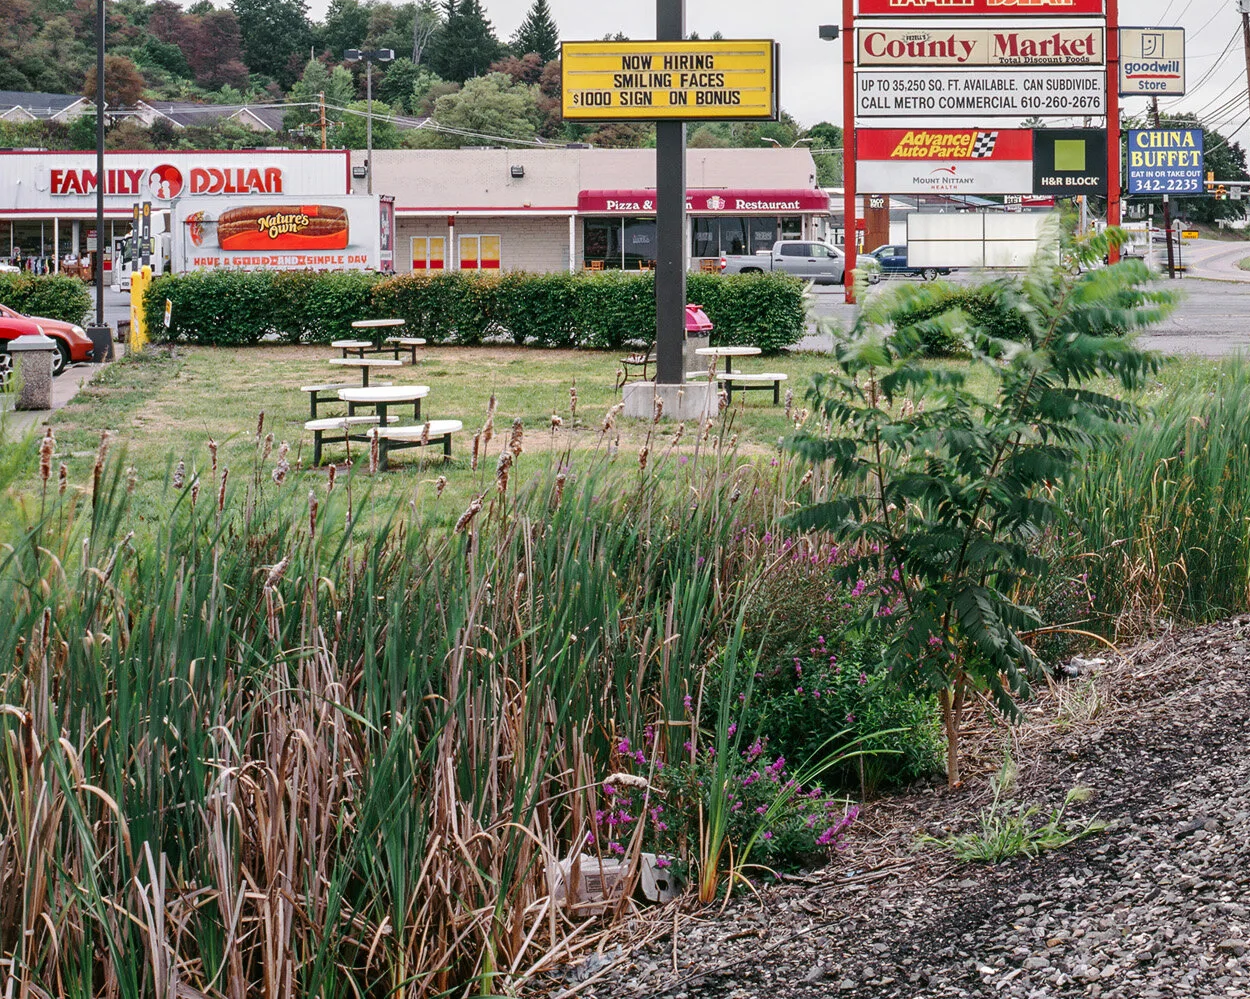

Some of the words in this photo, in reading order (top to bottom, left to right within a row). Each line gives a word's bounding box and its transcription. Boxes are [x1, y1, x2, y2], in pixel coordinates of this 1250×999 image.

[863, 32, 978, 62] County
[993, 32, 1097, 57] Market
[622, 55, 652, 71] NOW
[664, 55, 714, 70] HIRING
[1124, 61, 1180, 74] goodwill
[614, 73, 672, 88] SMILING
[680, 73, 724, 87] FACES
[861, 80, 874, 91] UP
[876, 80, 890, 91] TO
[892, 80, 926, 92] 35,250
[928, 80, 945, 91] SQ.
[948, 80, 961, 91] FT.
[963, 80, 1018, 91] AVAILABLE.
[1024, 79, 1043, 91] CAN
[1046, 79, 1101, 91] SUBDIVIDE.
[1138, 80, 1167, 90] Store
[573, 92, 611, 106] $1000
[620, 91, 652, 105] SIGN
[669, 91, 687, 105] ON
[696, 91, 740, 105] BONUS
[861, 97, 891, 109] CALL
[894, 97, 935, 109] METRO
[938, 96, 1018, 109] COMMERCIAL
[1021, 96, 1100, 108] 610-260-2676
[900, 131, 970, 145] Advance
[1136, 131, 1195, 148] CHINA
[891, 145, 927, 157] Auto
[927, 144, 967, 157] Parts
[1131, 150, 1201, 167] BUFFET
[190, 167, 283, 194] DOLLAR
[1041, 177, 1063, 185] H&R
[1065, 177, 1097, 185] BLOCK
[1135, 180, 1198, 191] 342-2235
[606, 200, 640, 210] Pizza
[643, 200, 653, 210] &
[736, 200, 800, 210] Restaurant
[257, 212, 310, 232] Nature's
[268, 223, 298, 239] Own
[193, 257, 220, 266] HAVE
[223, 257, 230, 266] A
[233, 256, 270, 266] GOOD
[277, 256, 298, 266] AND
[347, 255, 367, 264] DAY
